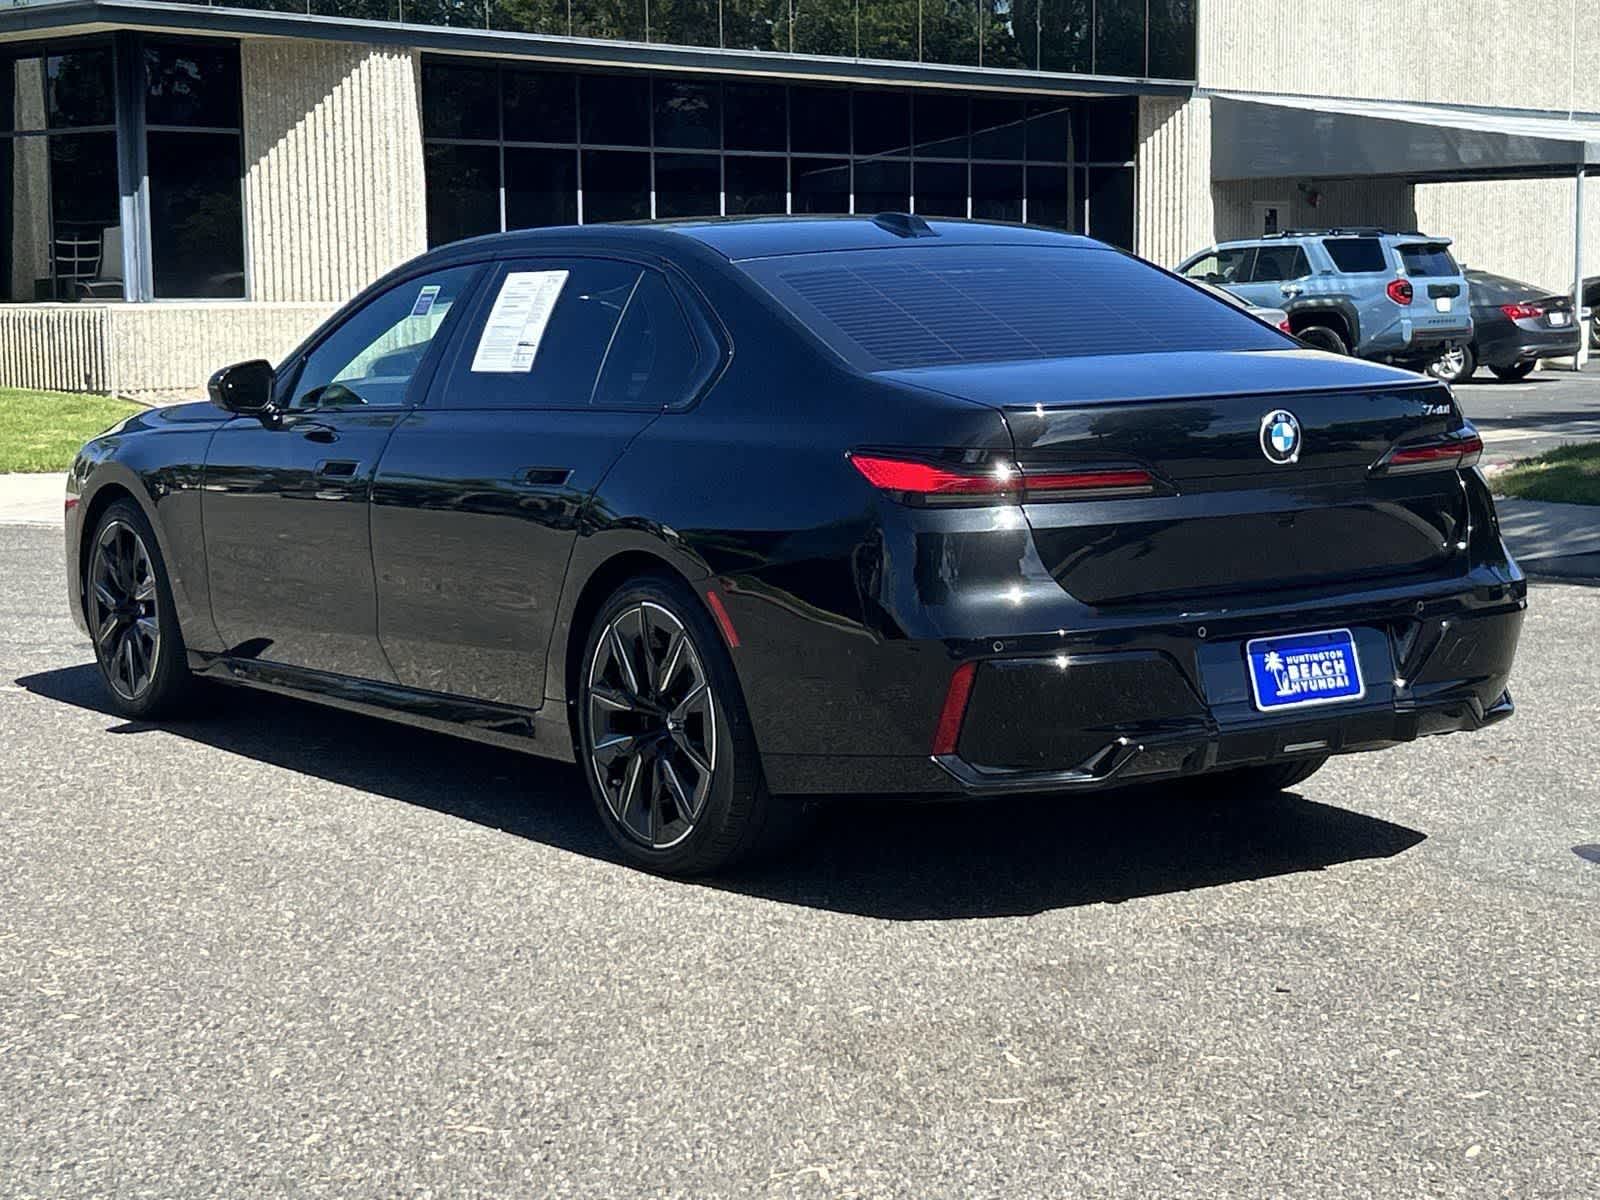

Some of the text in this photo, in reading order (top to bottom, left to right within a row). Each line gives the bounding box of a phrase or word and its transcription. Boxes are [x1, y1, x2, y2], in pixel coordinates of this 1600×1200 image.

[1286, 650, 1343, 664] HUNTINGTON
[1287, 659, 1346, 679] BEACH
[1291, 675, 1349, 693] HYUNDAI
